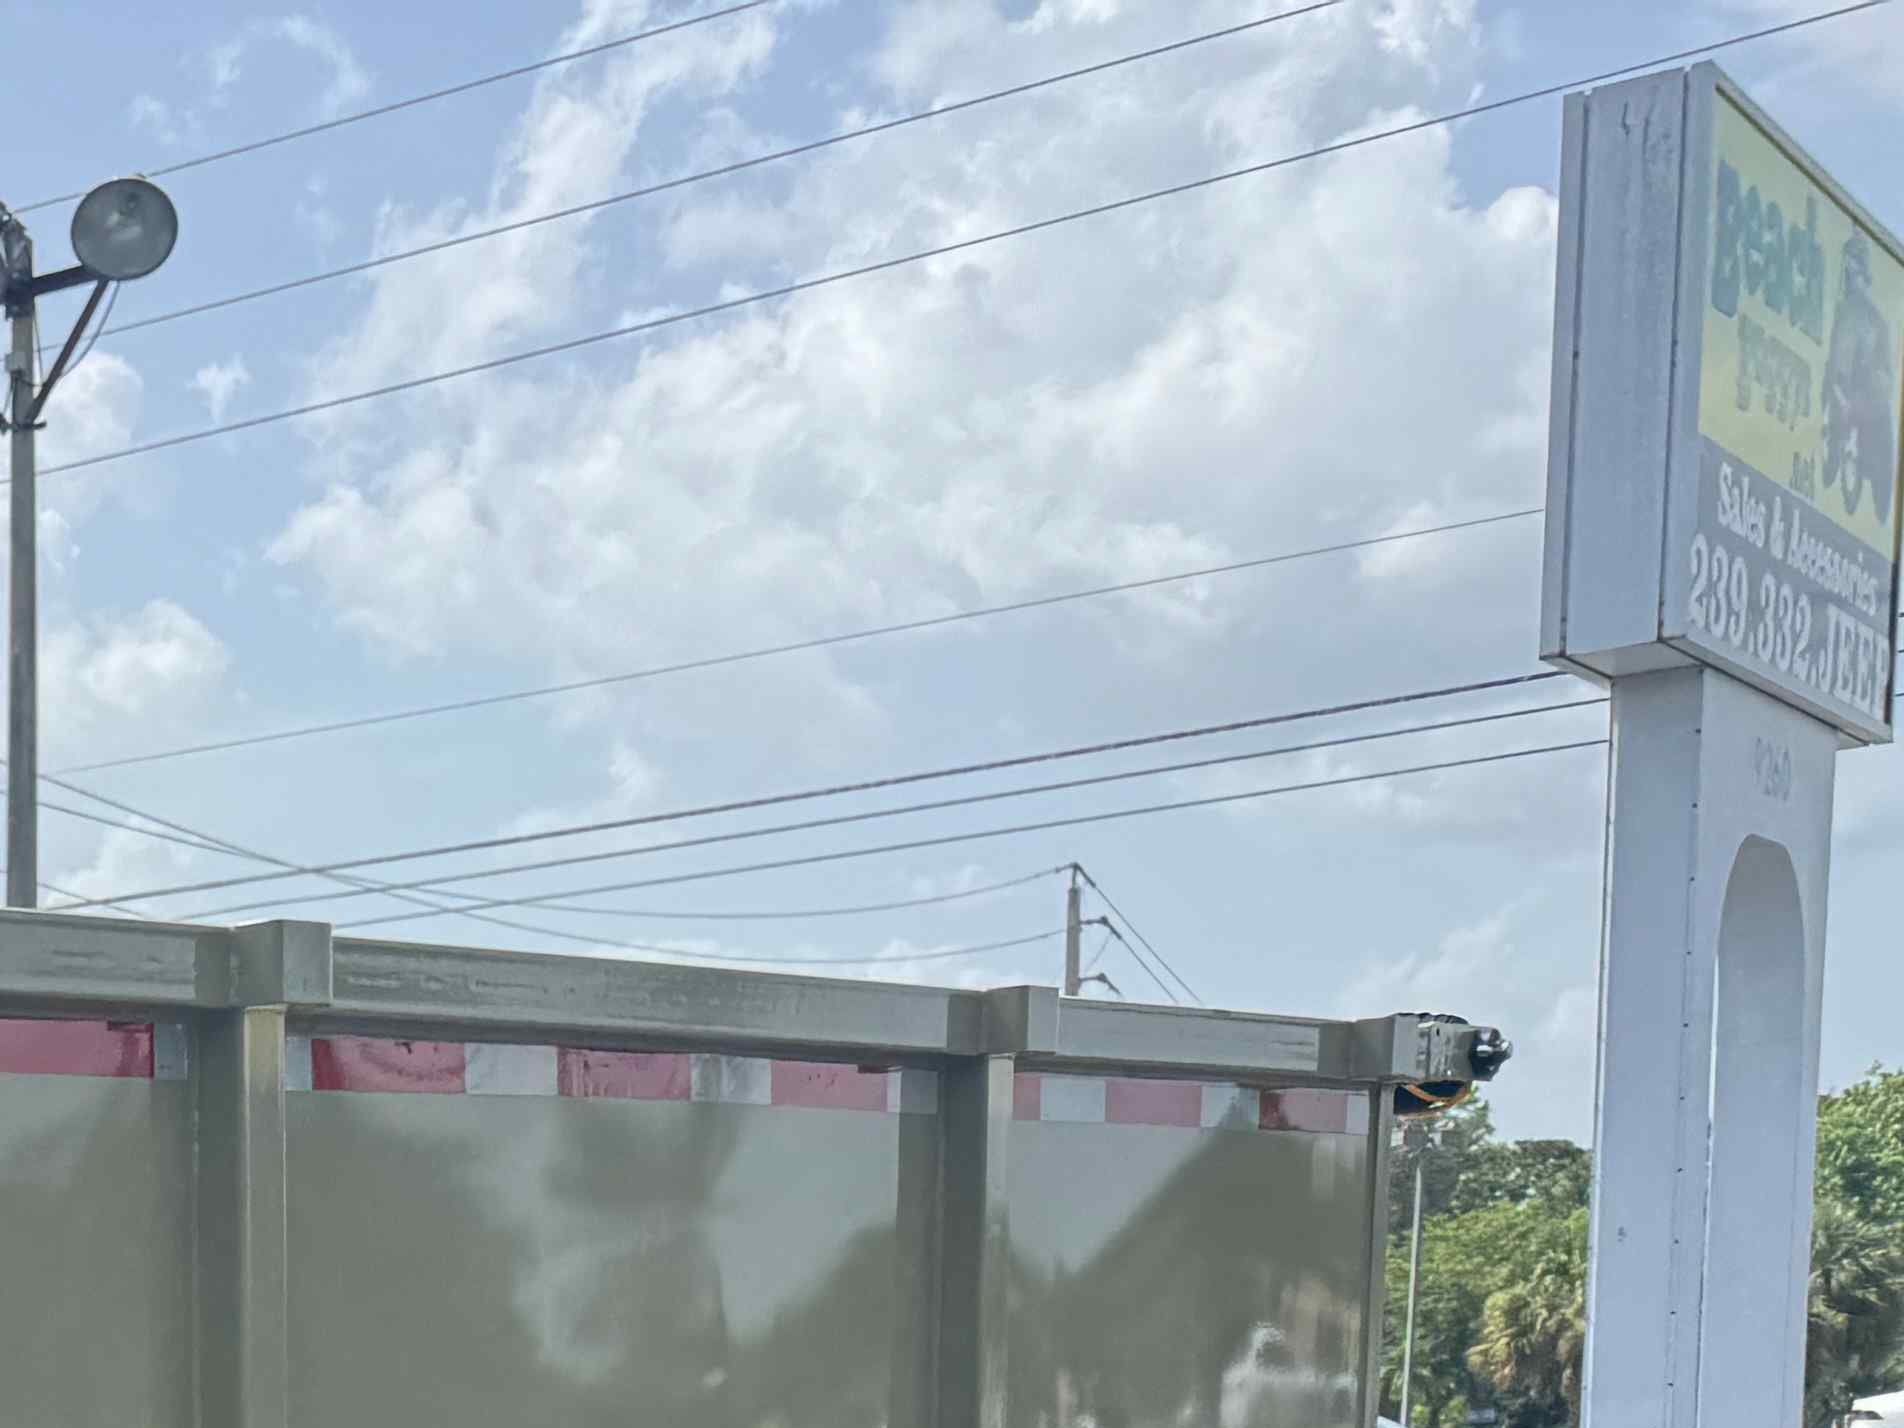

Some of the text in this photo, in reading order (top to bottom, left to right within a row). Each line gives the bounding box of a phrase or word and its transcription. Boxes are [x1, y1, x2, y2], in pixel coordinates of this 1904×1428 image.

[1718, 462, 1767, 549] Sales
[1769, 496, 1785, 560] &
[1787, 508, 1882, 617] Accessories
